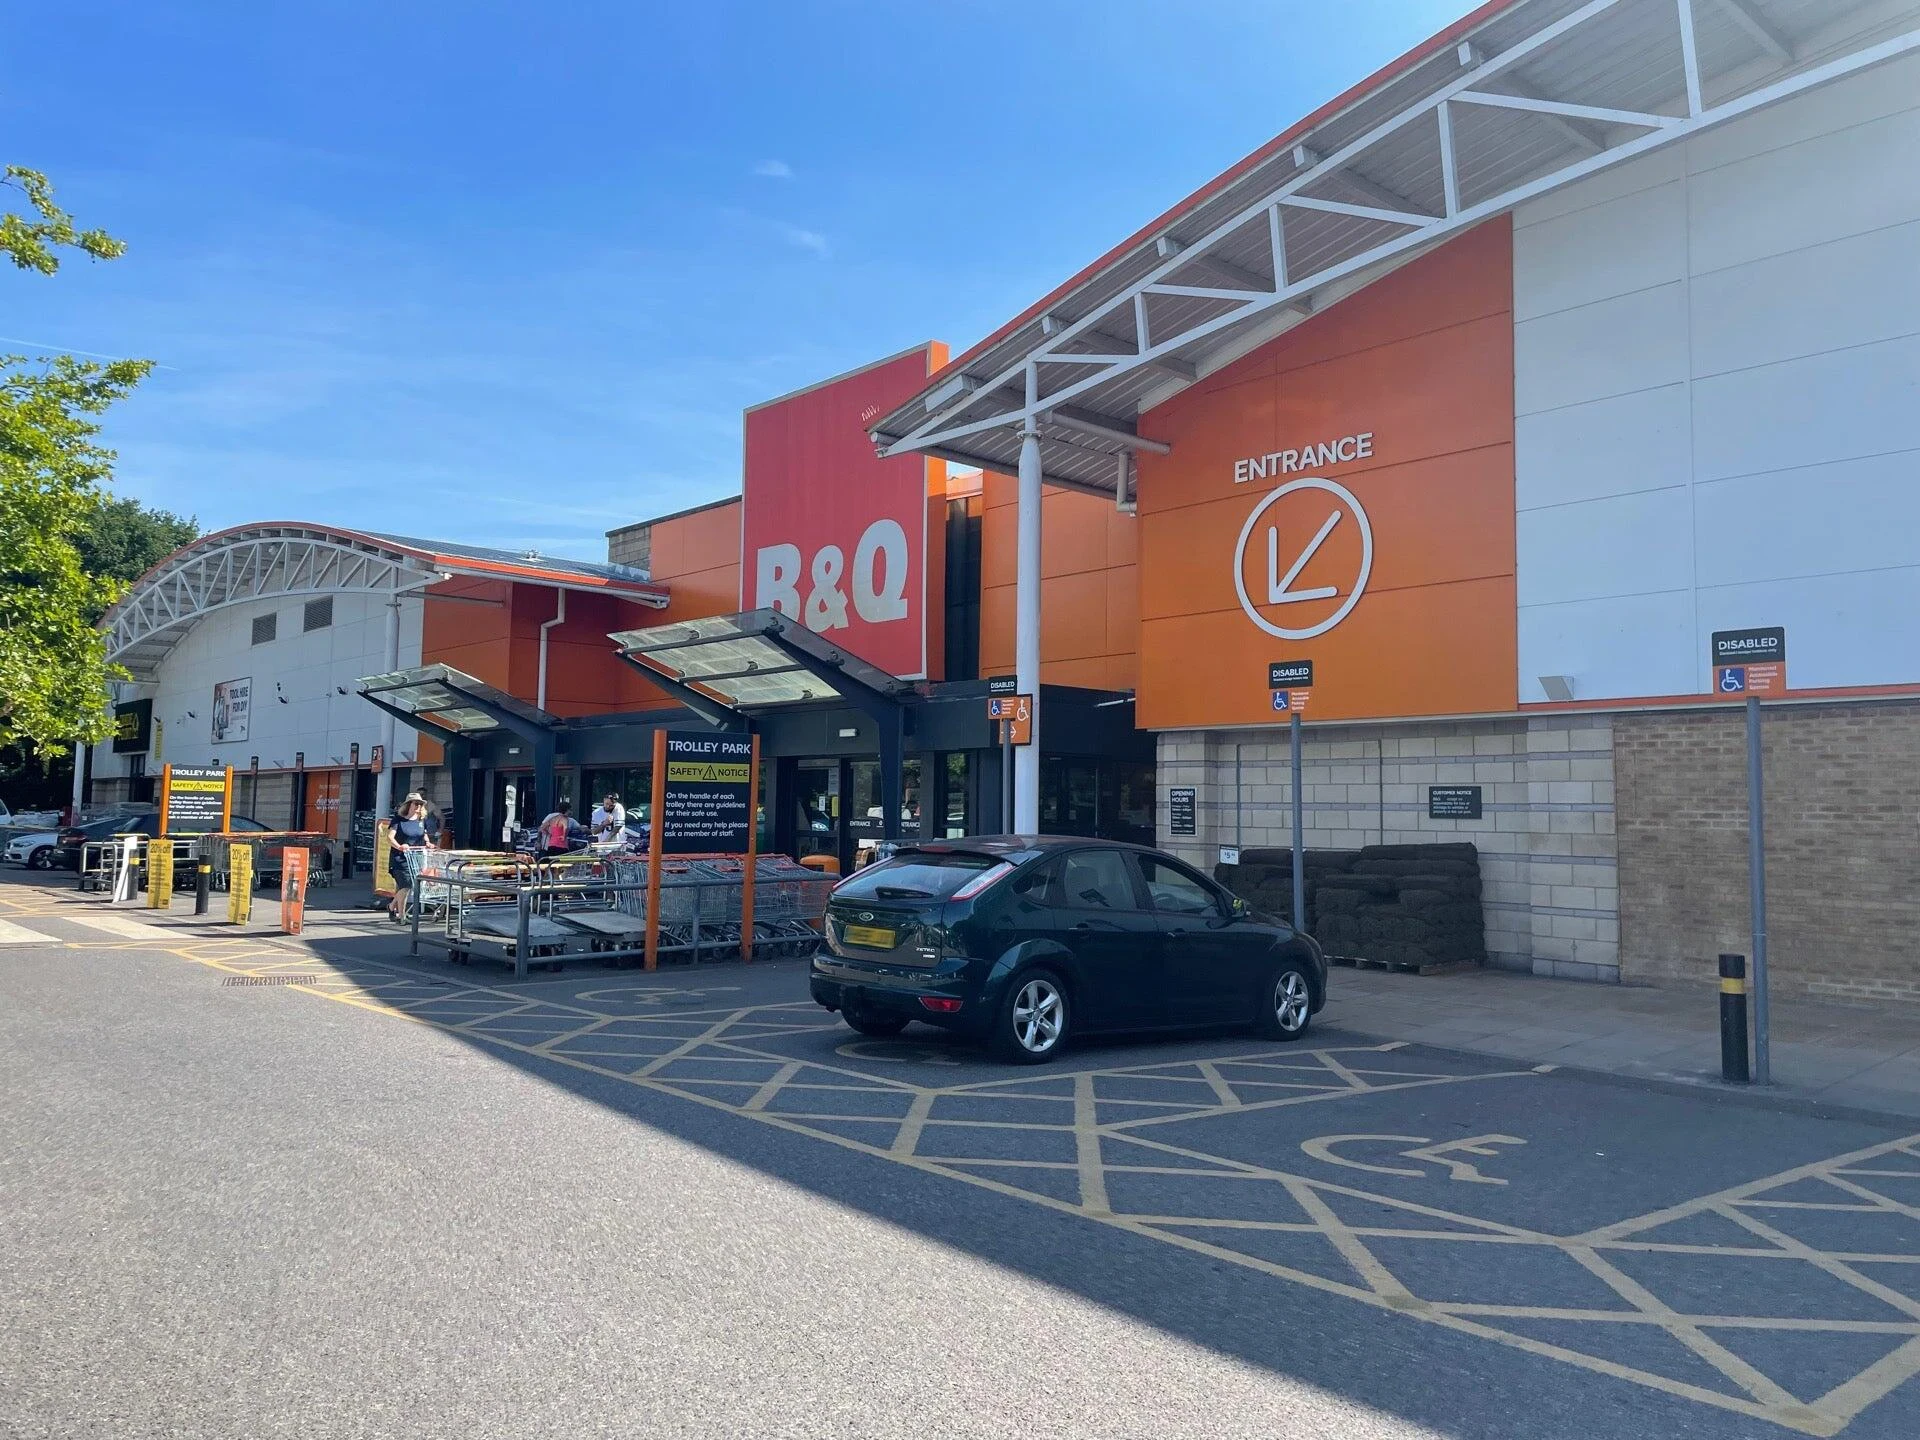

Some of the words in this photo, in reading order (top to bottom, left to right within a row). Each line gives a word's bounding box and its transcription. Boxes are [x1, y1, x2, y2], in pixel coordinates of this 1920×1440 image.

[1234, 432, 1373, 484] ENTRANCE
[756, 519, 908, 633] B&Q
[1718, 637, 1778, 650] DISABLED
[1272, 667, 1309, 678] DISABLED
[990, 681, 1015, 689] DISABLED
[668, 740, 719, 753] TROLLEY
[722, 743, 751, 754] PARK
[670, 767, 703, 776] SAFETY
[718, 768, 748, 777] NOTICE
[689, 792, 711, 800] handle
[666, 801, 685, 809] trolley
[716, 801, 746, 810] guidelines
[714, 822, 727, 830] help
[728, 822, 749, 830] please
[150, 843, 162, 854] 20%
[162, 845, 172, 854] off
[231, 848, 242, 861] 20%
[242, 851, 250, 861] off
